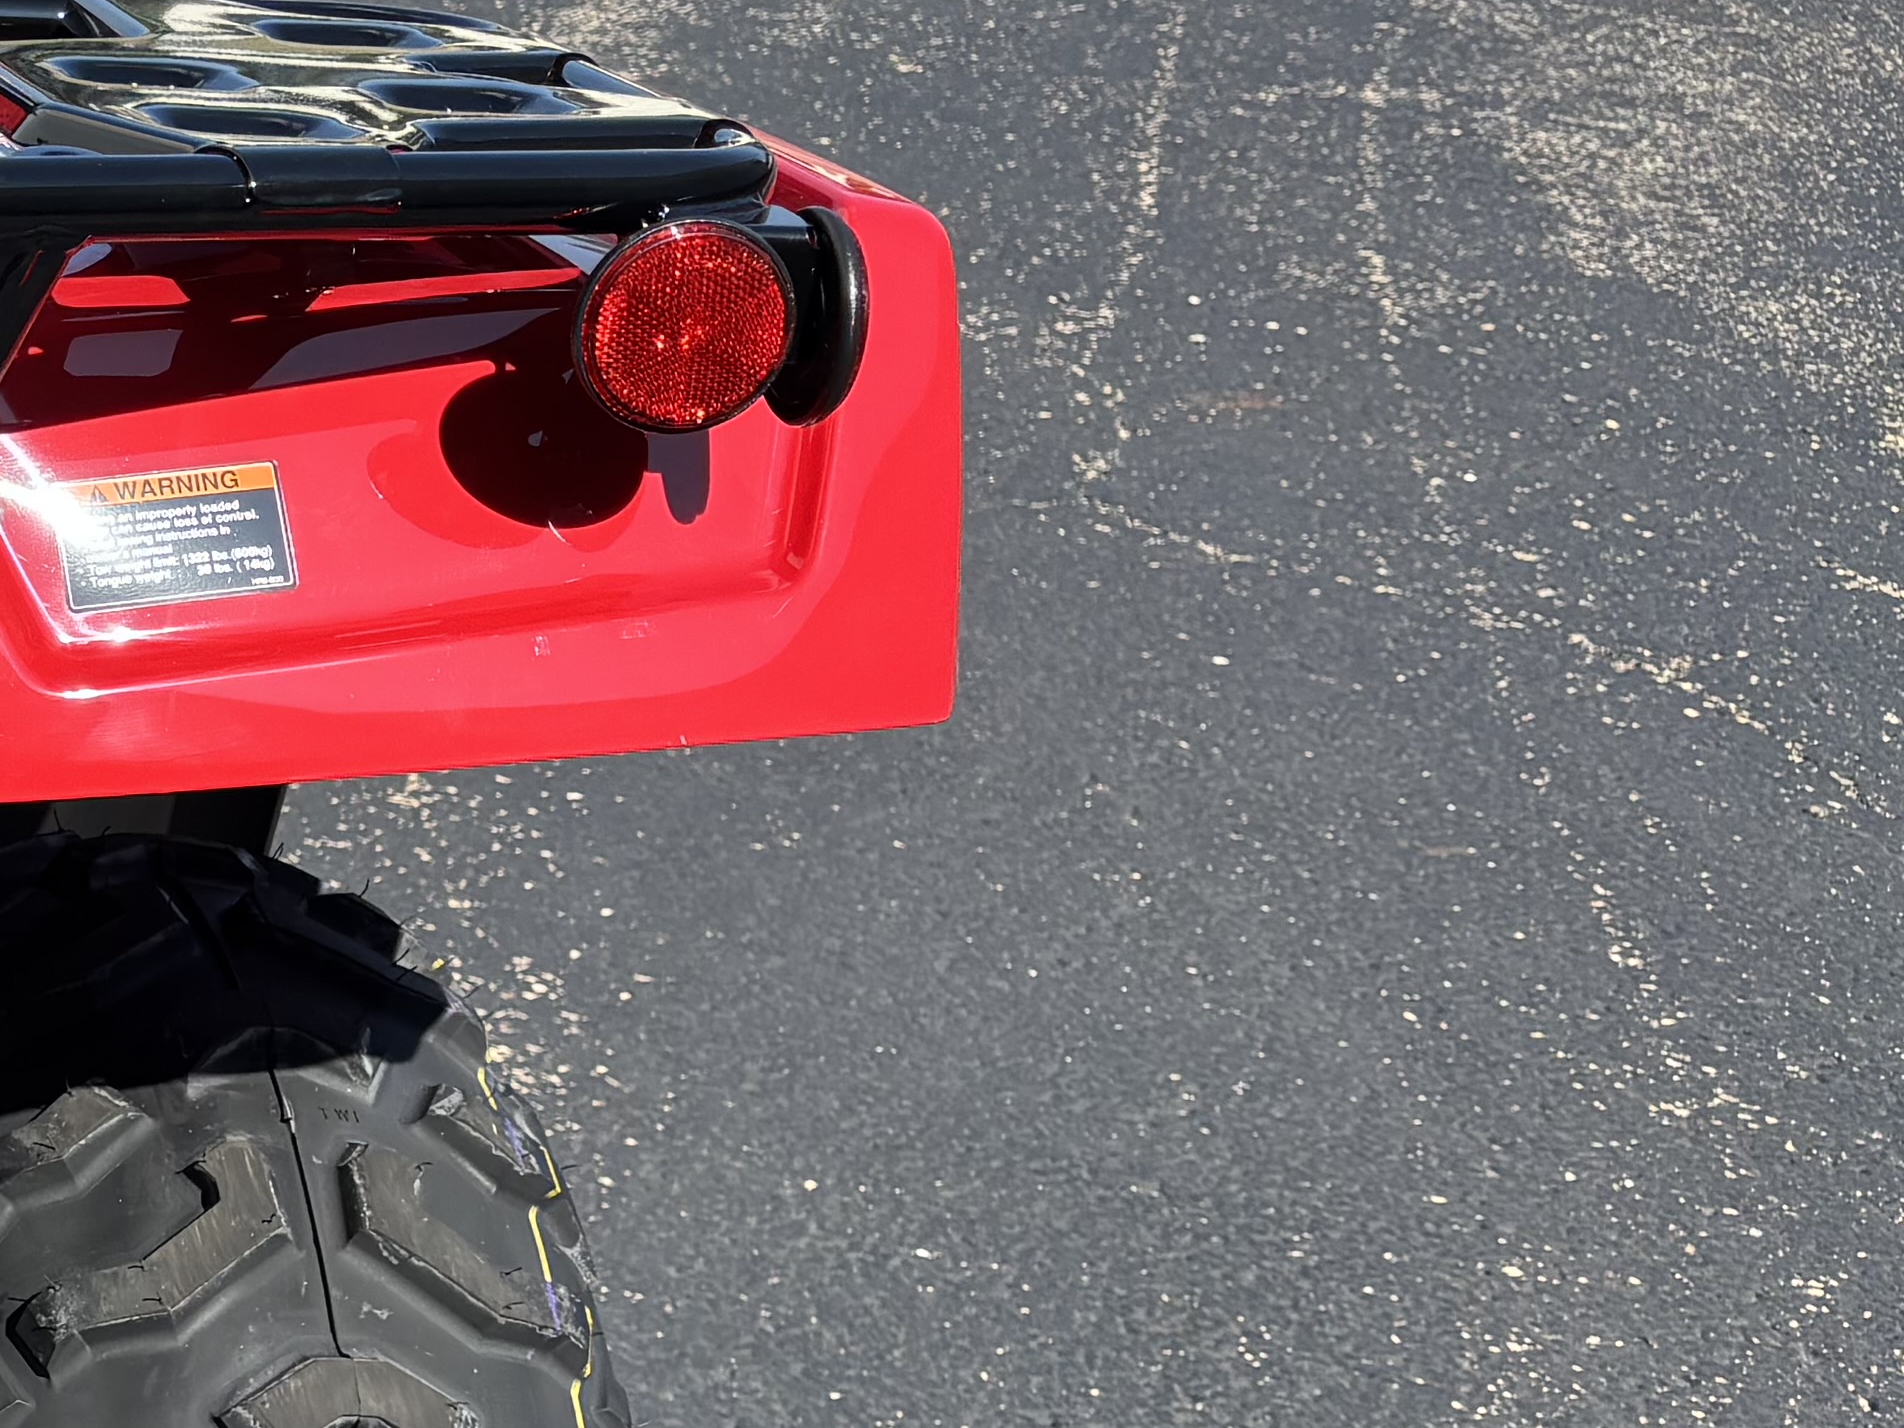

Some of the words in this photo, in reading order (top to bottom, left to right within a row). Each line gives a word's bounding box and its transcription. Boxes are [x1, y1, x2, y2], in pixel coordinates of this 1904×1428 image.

[113, 470, 240, 501] WARNING
[135, 504, 197, 521] improperly
[200, 500, 239, 514] loaded
[136, 520, 171, 532] cause
[174, 516, 198, 528] loss
[201, 513, 213, 524] of
[215, 509, 260, 523] control.
[155, 525, 218, 543] instructions
[318, 1105, 360, 1124] TWI
